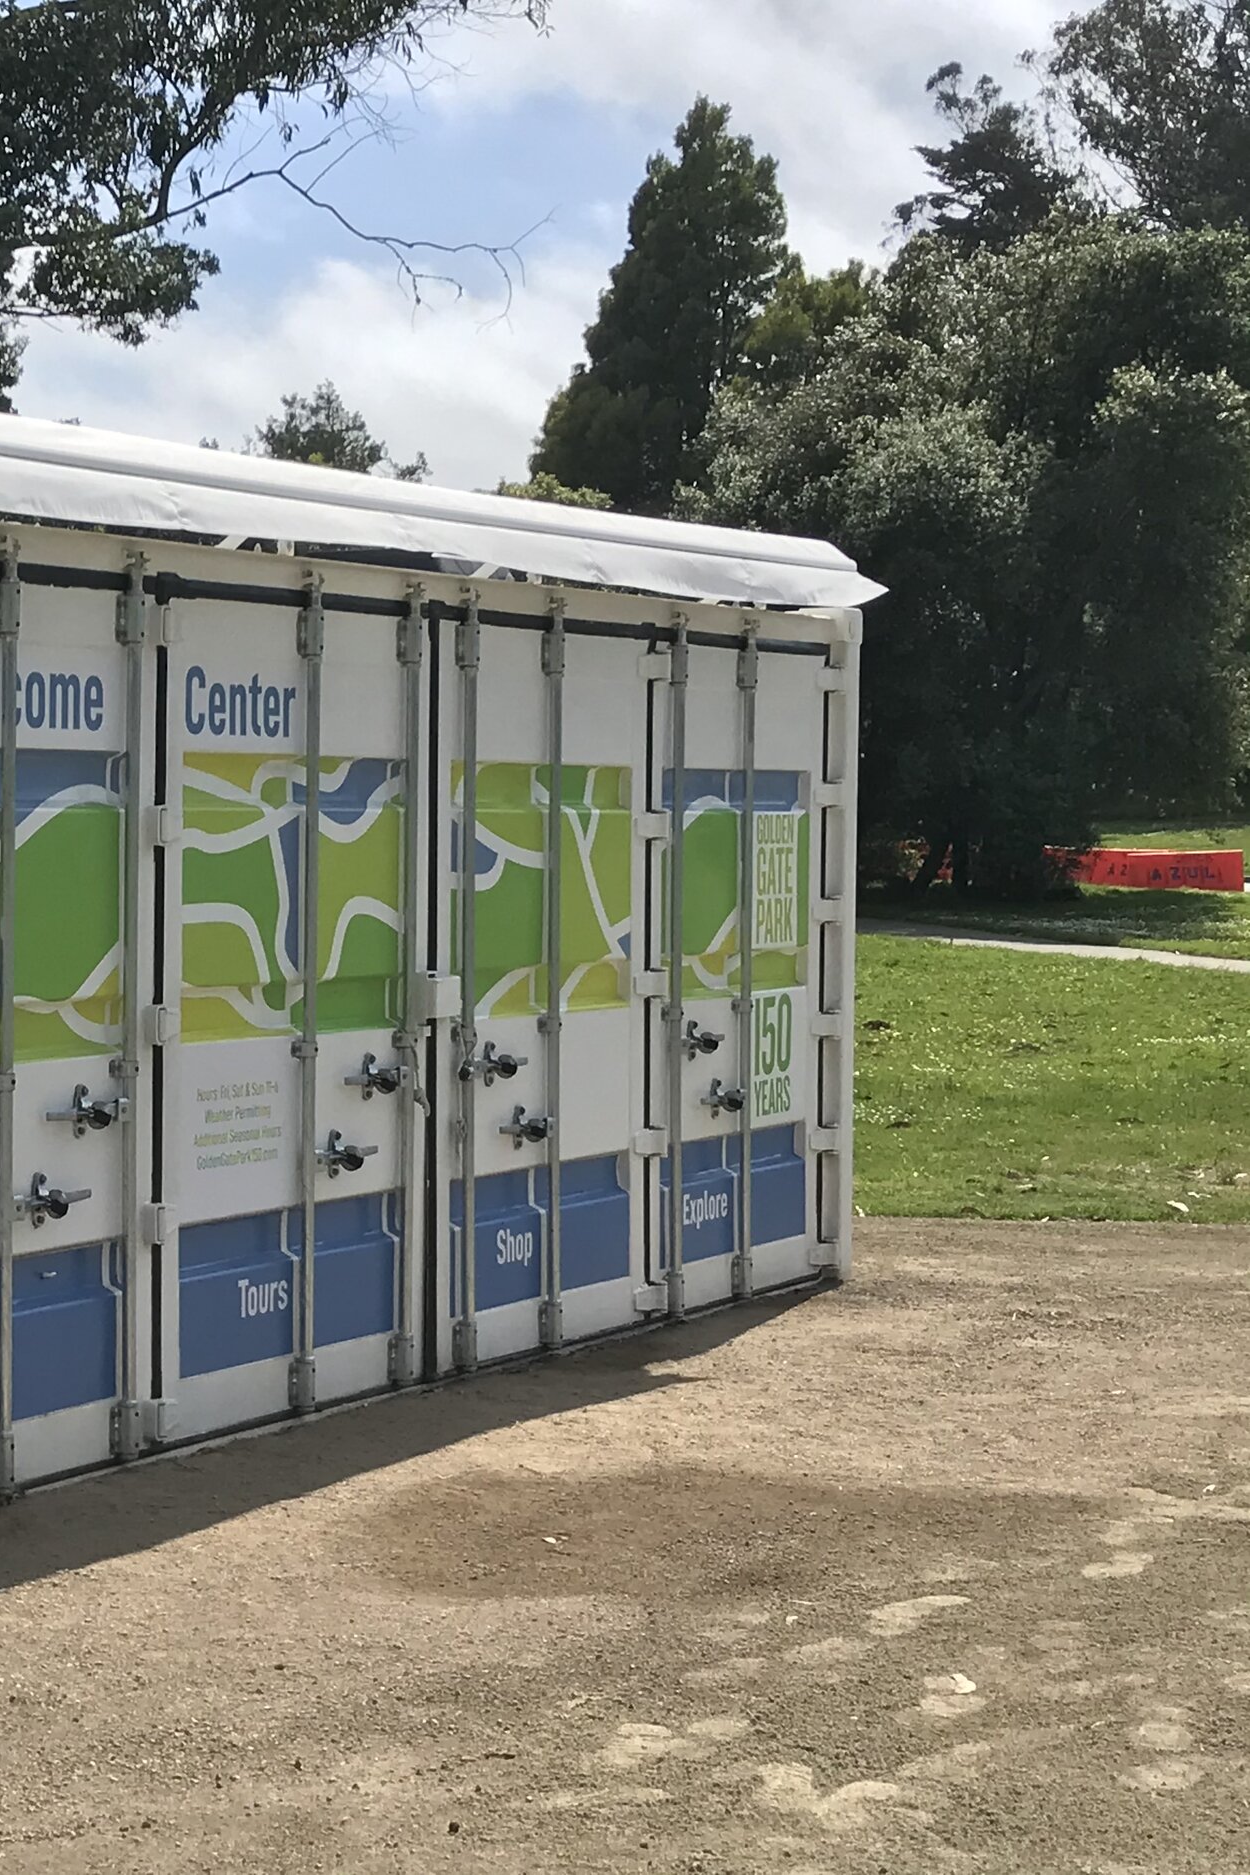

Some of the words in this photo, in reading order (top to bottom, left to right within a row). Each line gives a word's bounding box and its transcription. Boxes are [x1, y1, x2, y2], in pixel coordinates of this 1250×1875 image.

[184, 666, 296, 738] Center
[756, 814, 794, 845] GOLDEN
[756, 846, 794, 896] GATE
[756, 897, 793, 944] PARK
[754, 993, 792, 1076] 150
[754, 1075, 791, 1117] YEARS
[683, 1190, 728, 1230] Explore
[496, 1229, 533, 1267] Shop
[237, 1278, 289, 1319] Tours
